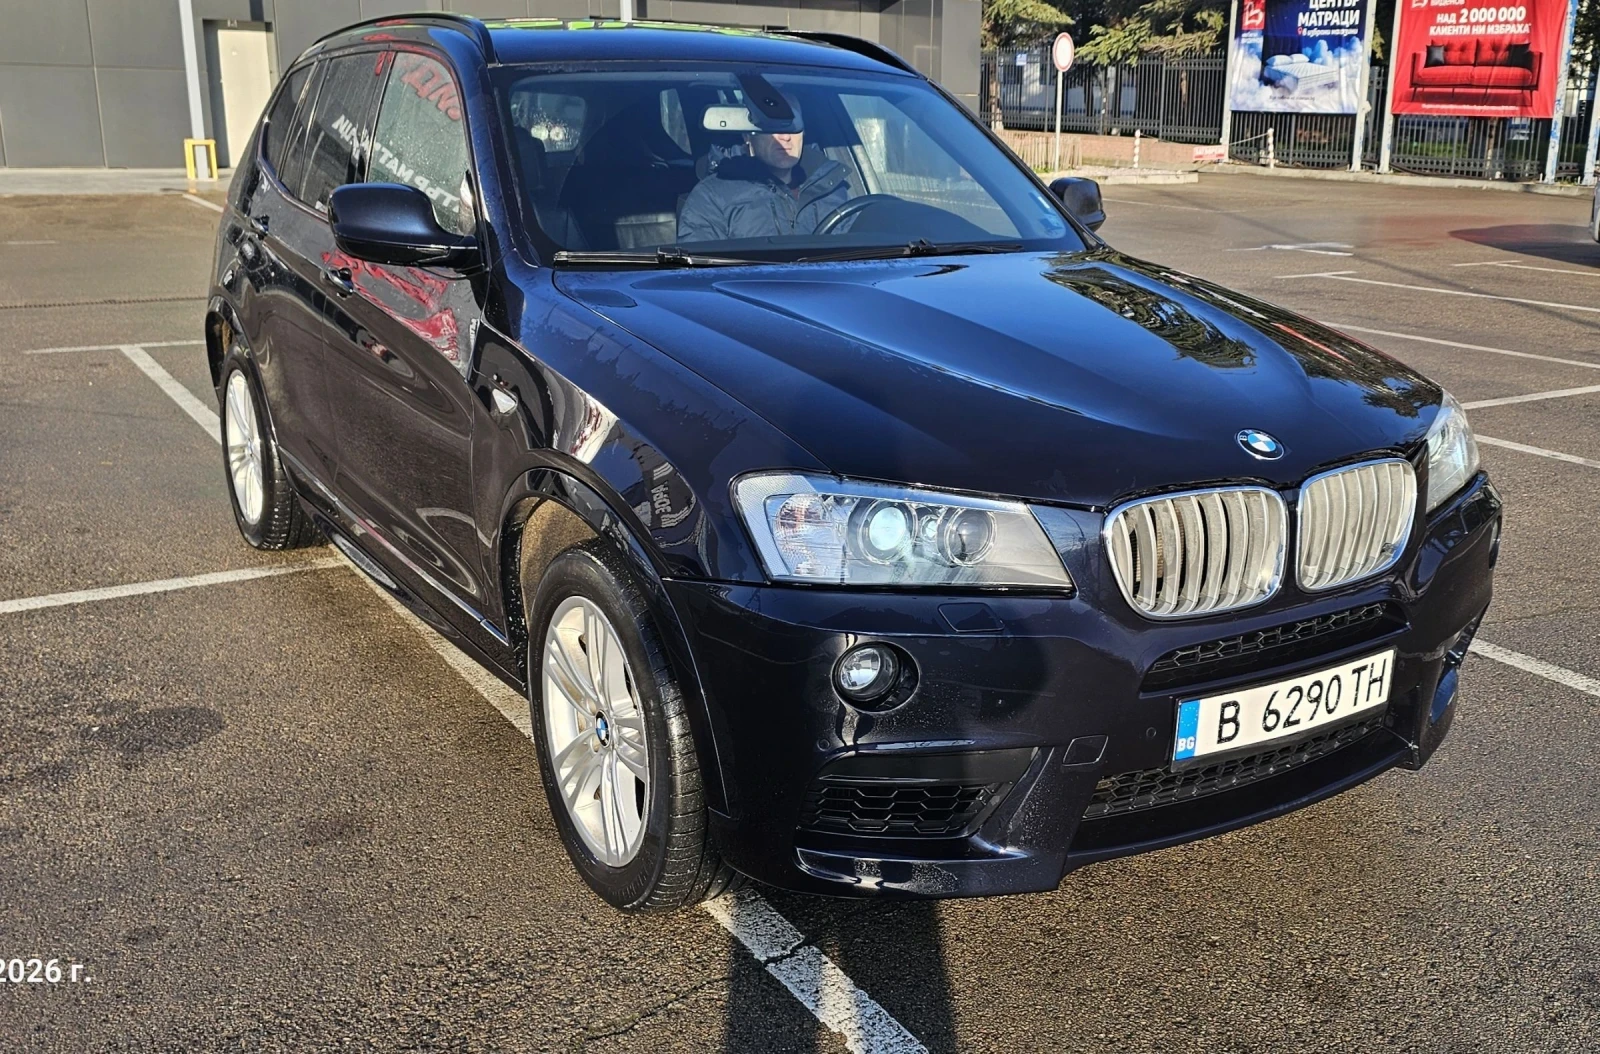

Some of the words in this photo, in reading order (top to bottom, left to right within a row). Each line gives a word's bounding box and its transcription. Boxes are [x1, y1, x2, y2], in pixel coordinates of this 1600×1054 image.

[1297, 10, 1361, 27] МАТРАЦИ
[1436, 13, 1456, 24] НАД
[1429, 25, 1471, 36] КЛИЕНТИ
[1471, 24, 1486, 35] НИ
[1216, 700, 1241, 744] B
[1261, 674, 1342, 732] 6290
[1351, 658, 1387, 707] TH
[1177, 737, 1195, 749] BG
